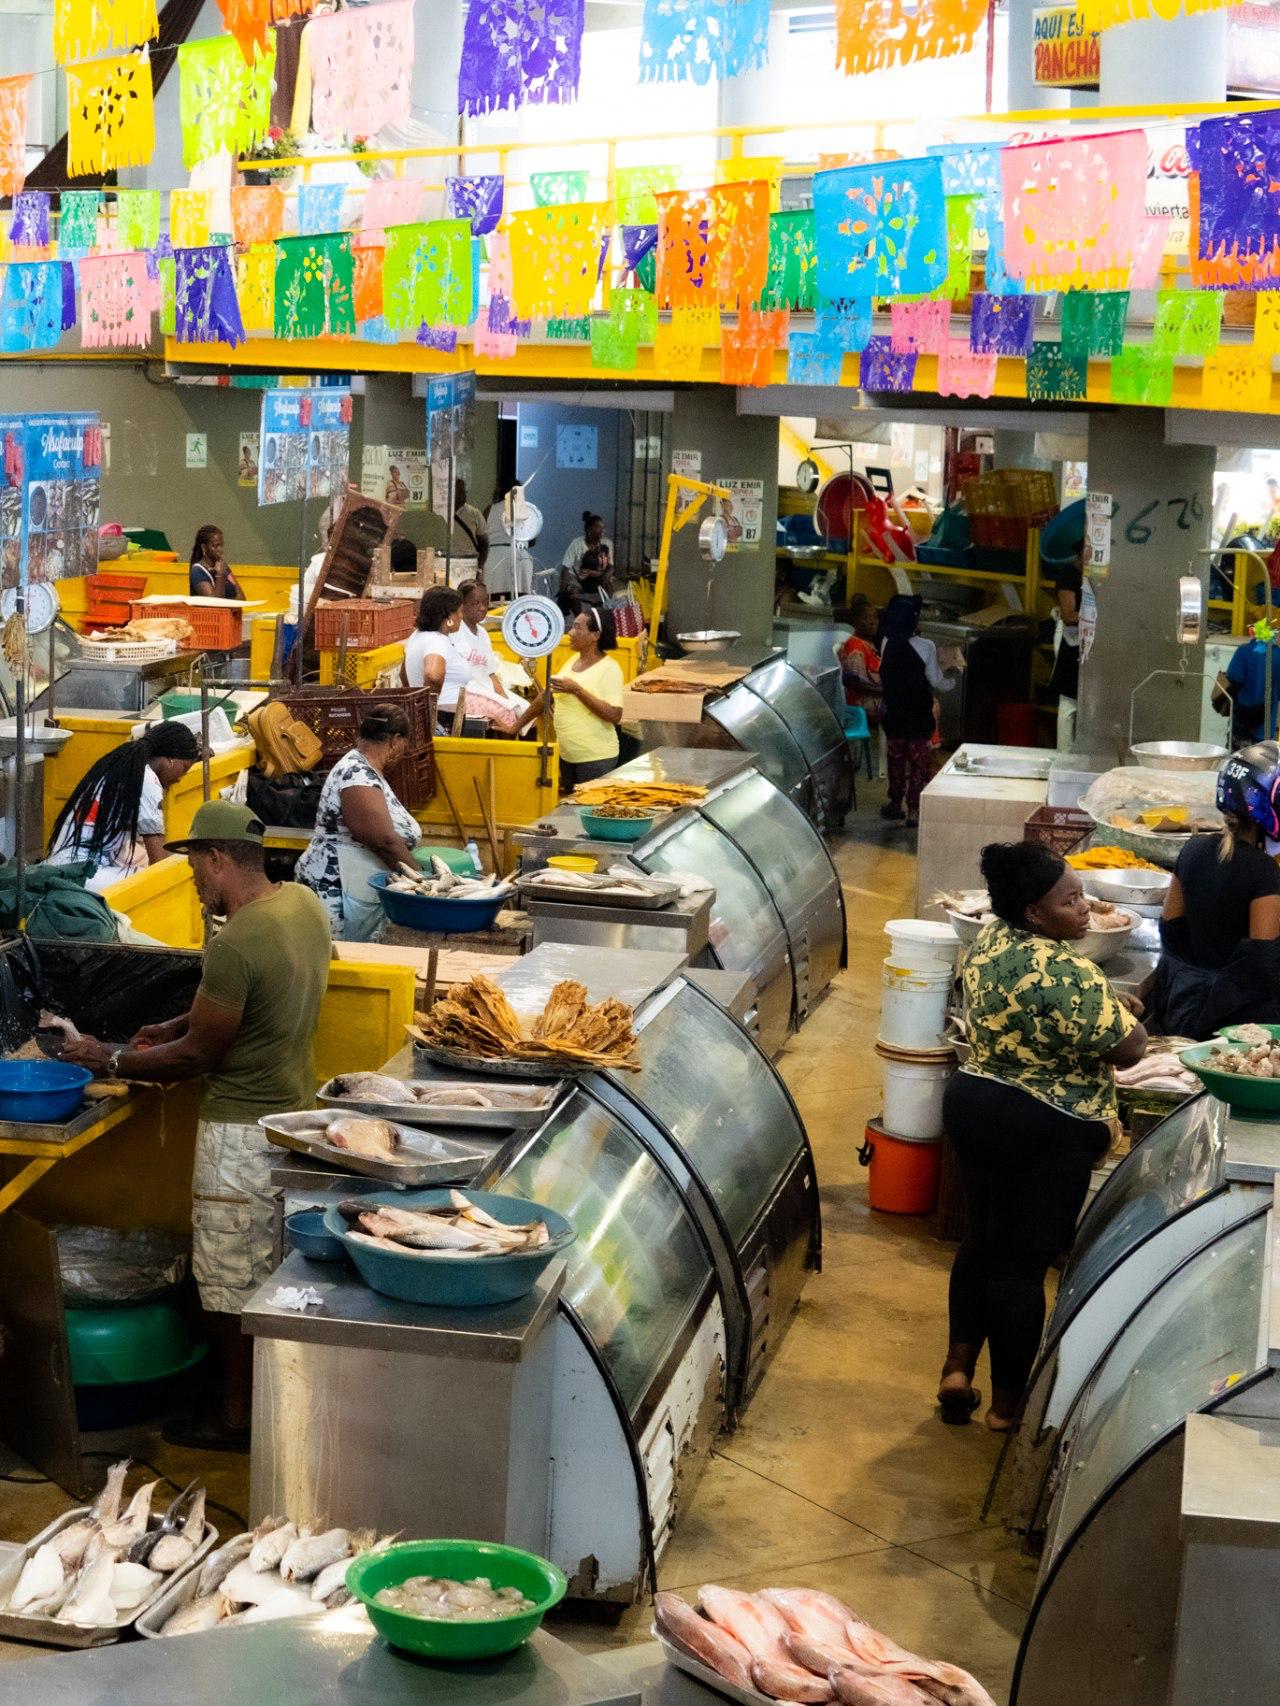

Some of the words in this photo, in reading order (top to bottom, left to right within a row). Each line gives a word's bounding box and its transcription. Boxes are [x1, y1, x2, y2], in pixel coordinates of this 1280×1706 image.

[1035, 14, 1063, 40] AQUI
[41, 426, 83, 459] Asofaculp
[740, 481, 761, 489] EMIR
[412, 490, 423, 501] 87
[745, 528, 757, 540] 87
[1094, 550, 1104, 563] 87
